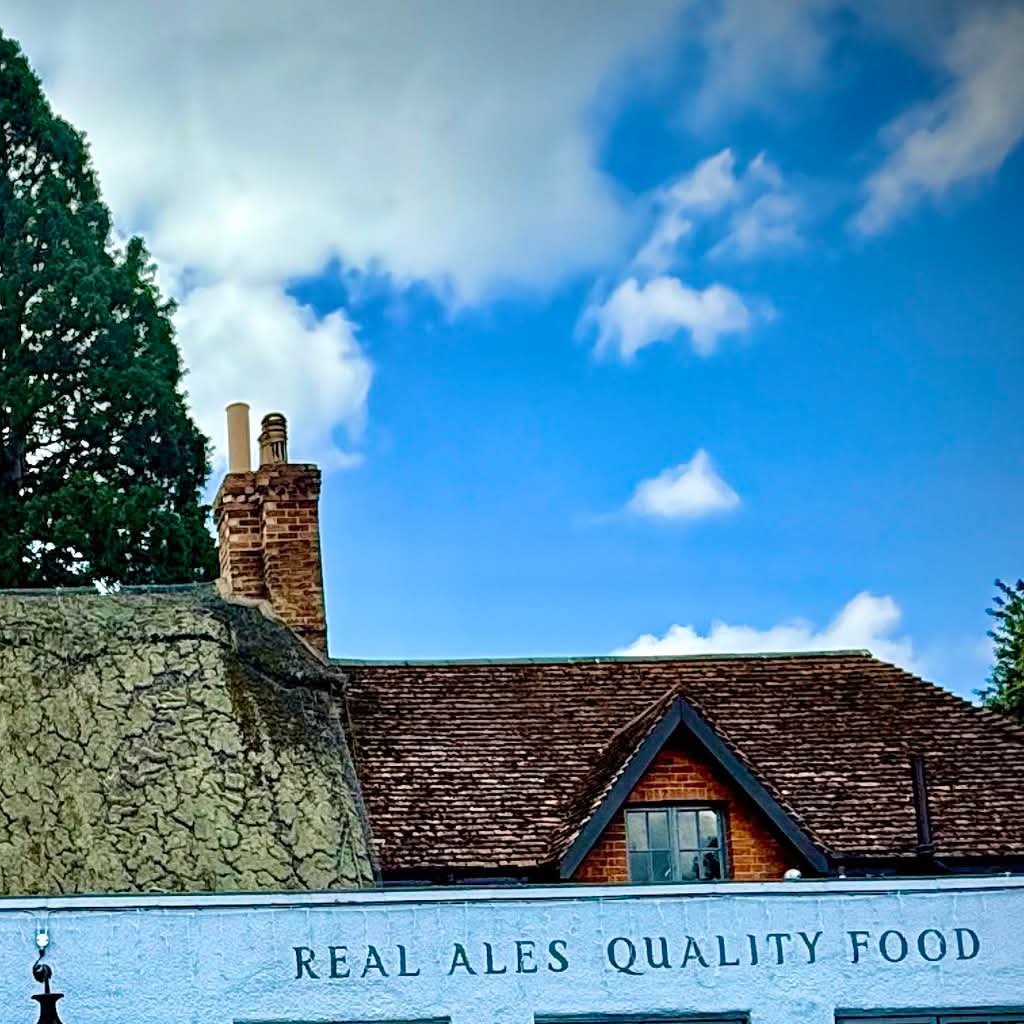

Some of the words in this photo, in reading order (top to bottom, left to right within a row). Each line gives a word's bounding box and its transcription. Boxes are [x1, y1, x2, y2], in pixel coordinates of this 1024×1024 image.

[292, 944, 421, 980] REAL
[447, 939, 570, 976] ALES
[606, 930, 824, 976] QUALITY
[846, 927, 981, 964] FOOD
